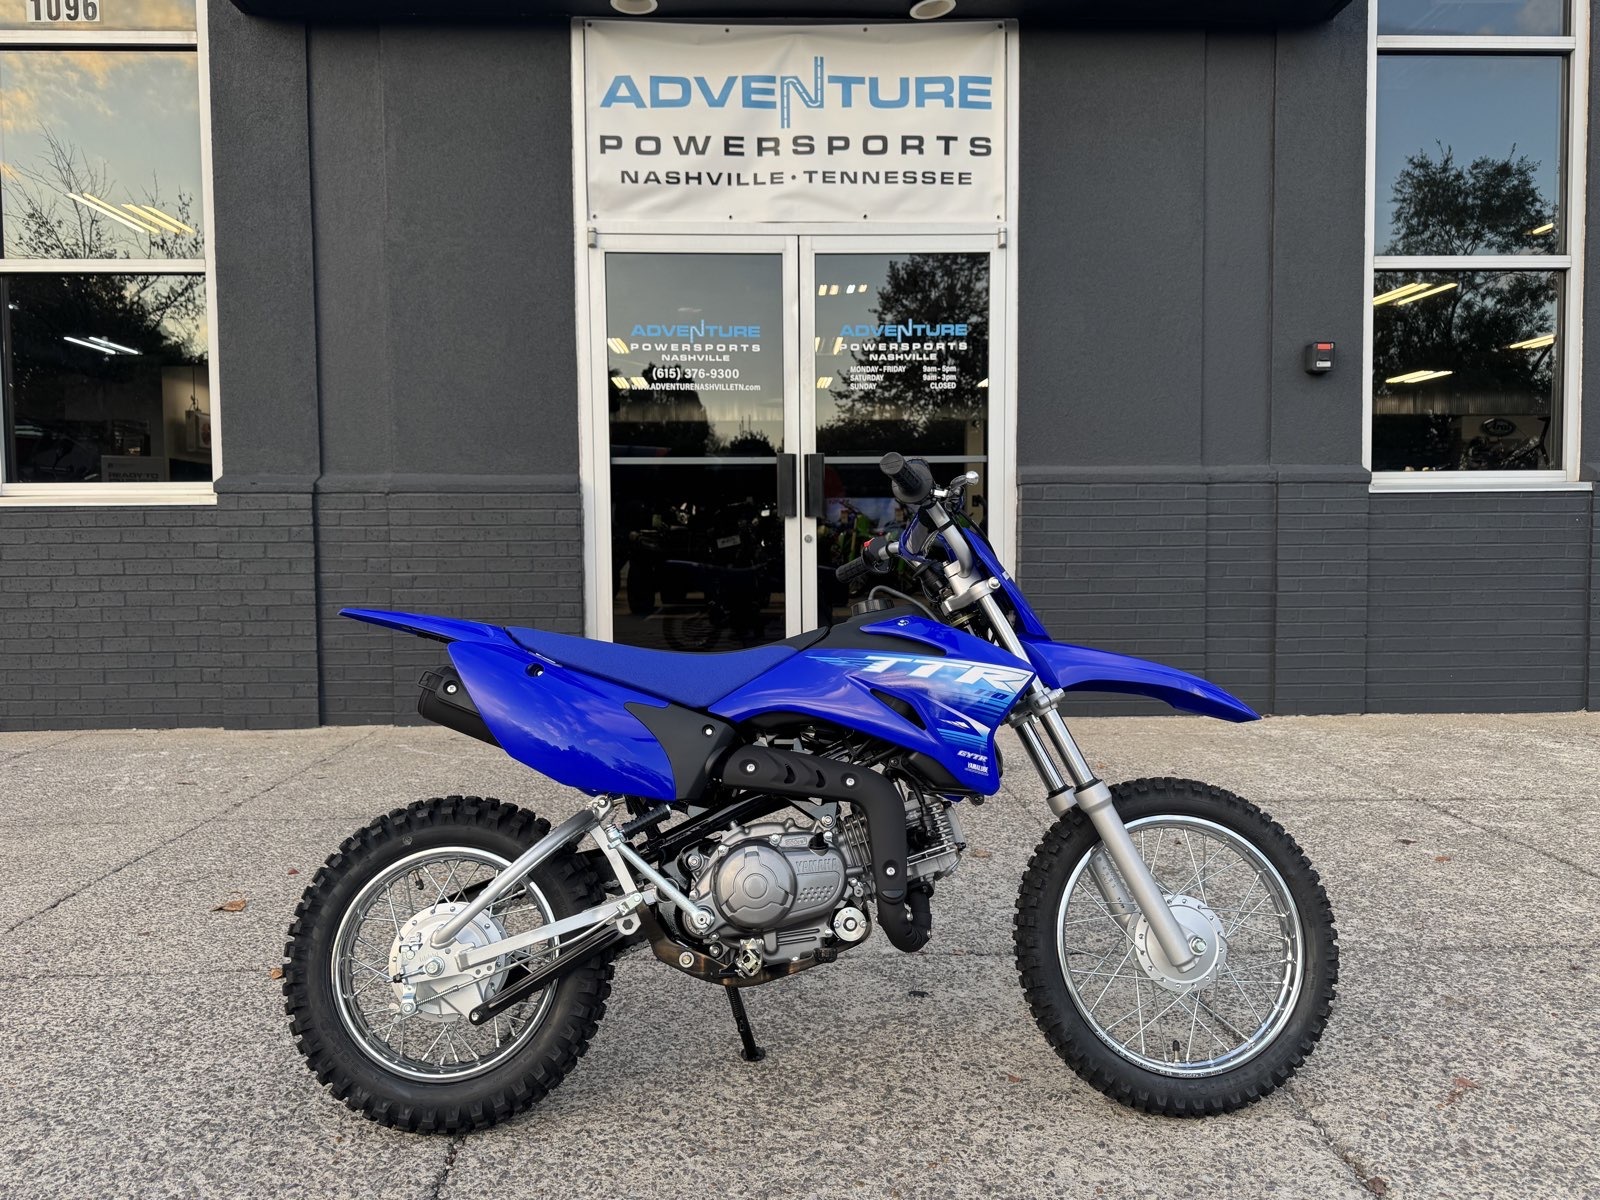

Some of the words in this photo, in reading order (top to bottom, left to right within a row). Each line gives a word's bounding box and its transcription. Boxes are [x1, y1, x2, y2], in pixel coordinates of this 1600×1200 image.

[30, 0, 98, 21] 1096
[599, 56, 993, 129] ADVENTURE
[599, 134, 993, 157] POWERSPORTS
[630, 319, 761, 343] ADVENTURE
[840, 318, 968, 342] ADVENTURE
[630, 343, 761, 352] POWERSPORTS
[839, 342, 968, 351] POWERSPORTS
[661, 354, 731, 362] NASHVILLE
[869, 353, 937, 361] NASHVILLE
[652, 367, 681, 381] (615)
[684, 368, 740, 379] 376-9300
[850, 382, 877, 390] SUNDAY
[861, 655, 1035, 694] TTR
[957, 749, 989, 763] GYTR
[794, 857, 839, 873] YAMAHA
